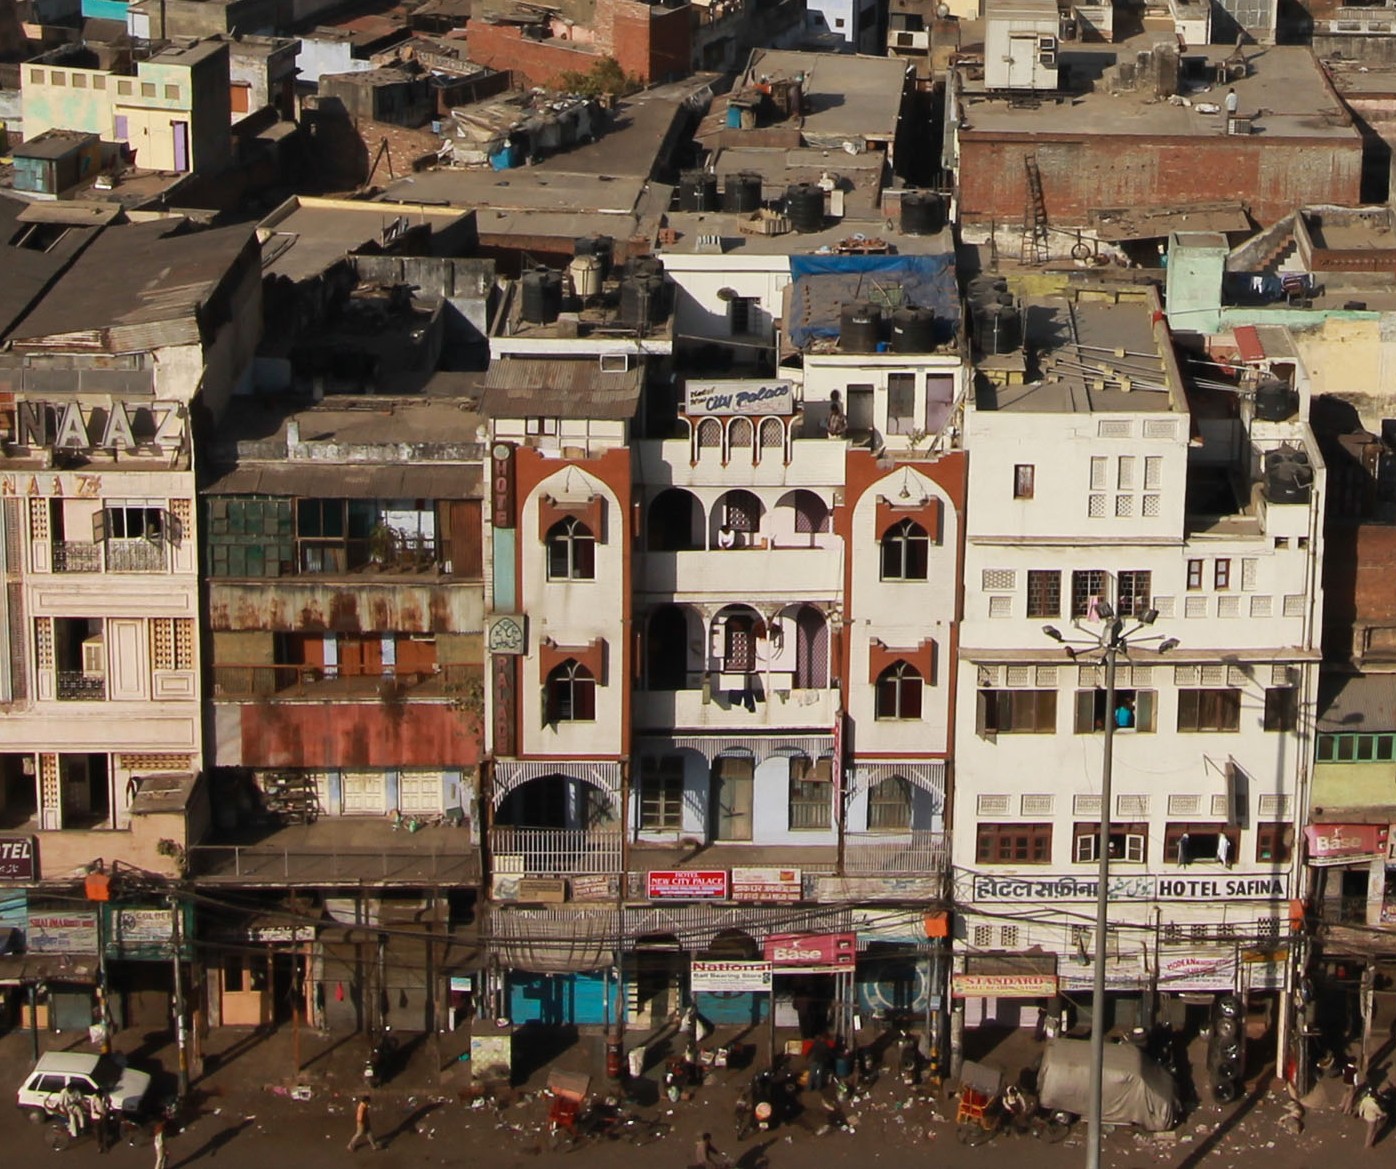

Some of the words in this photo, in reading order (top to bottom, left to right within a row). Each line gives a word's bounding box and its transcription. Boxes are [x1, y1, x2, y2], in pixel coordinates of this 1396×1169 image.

[706, 395, 733, 411] City
[736, 385, 789, 407] Palace
[17, 400, 184, 448] NAAZ
[0, 843, 31, 859] TEL
[1317, 837, 1361, 850] Base
[1159, 880, 1220, 897] HOTEL
[1226, 880, 1284, 895] SAFINA
[774, 949, 821, 961] Base
[693, 963, 771, 971] National
